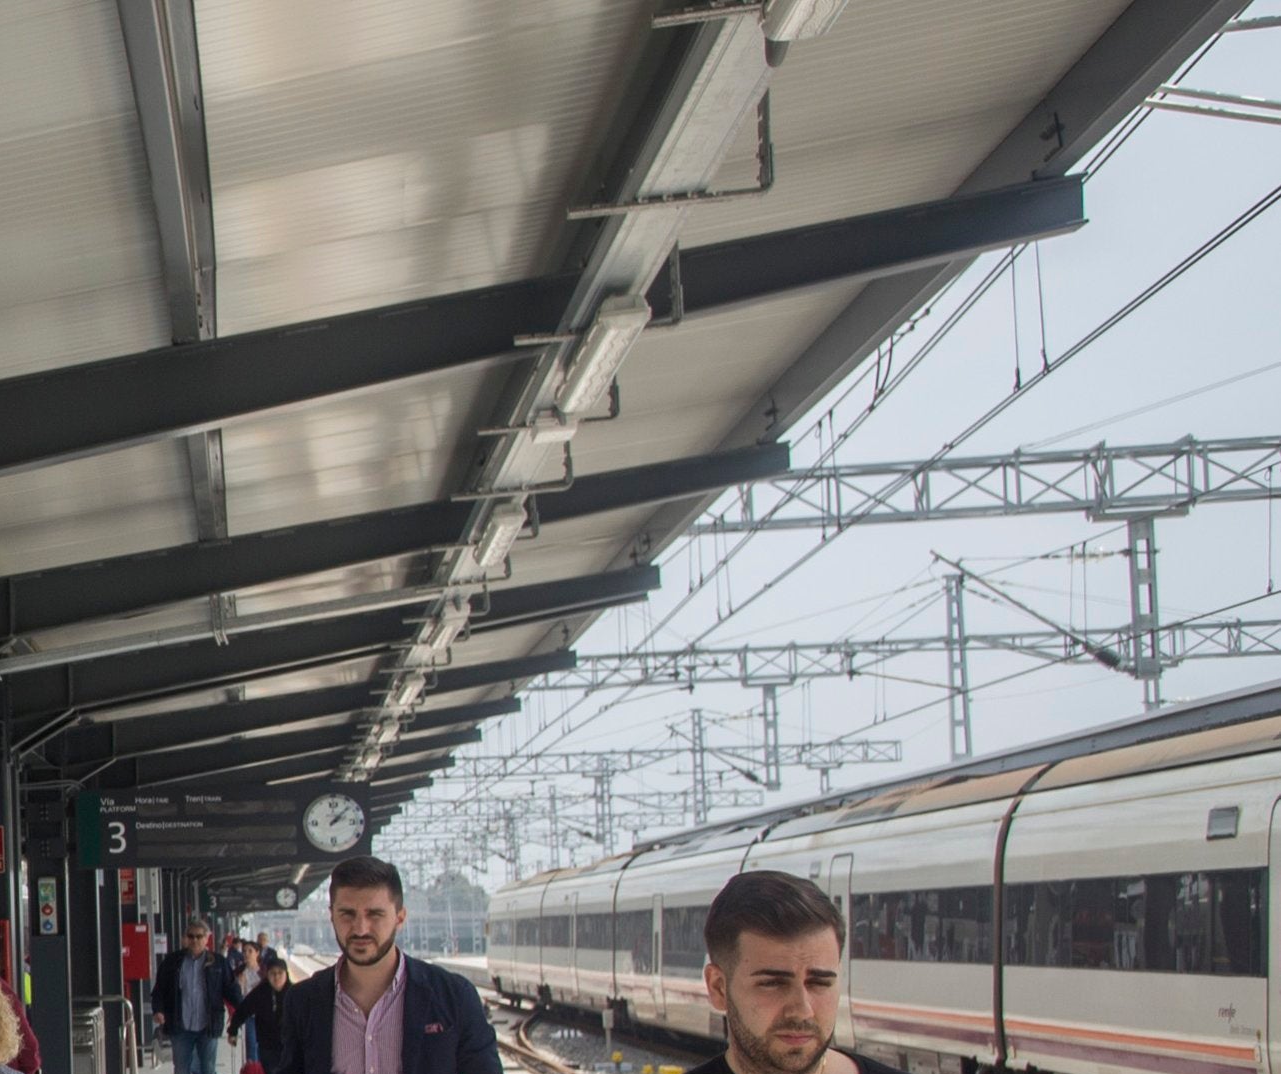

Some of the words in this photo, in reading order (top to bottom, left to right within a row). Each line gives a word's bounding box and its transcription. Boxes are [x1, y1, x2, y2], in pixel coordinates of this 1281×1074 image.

[99, 805, 137, 814] PLATFORM
[107, 821, 128, 855] 3
[209, 895, 218, 908] 3
